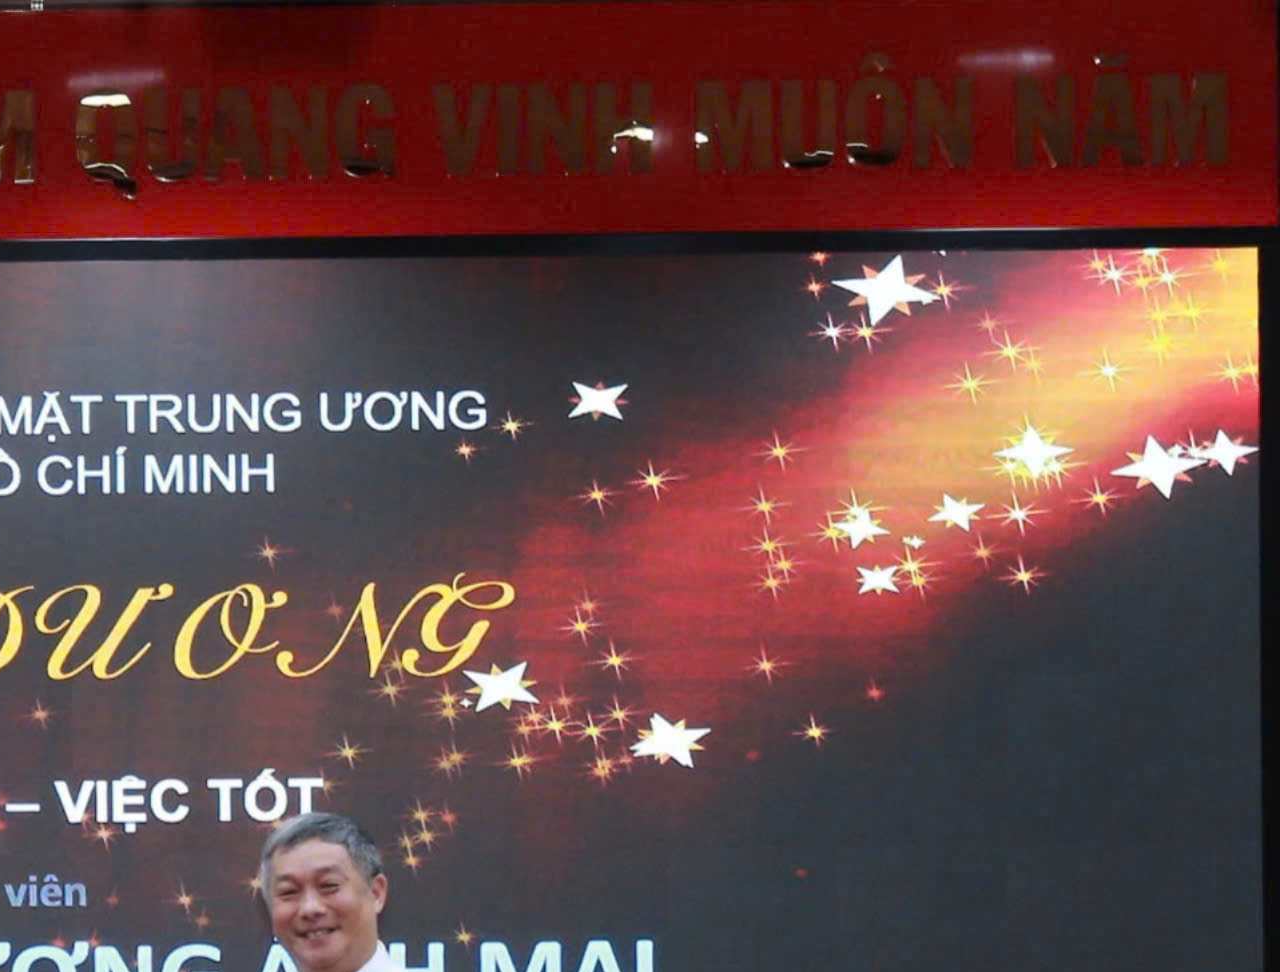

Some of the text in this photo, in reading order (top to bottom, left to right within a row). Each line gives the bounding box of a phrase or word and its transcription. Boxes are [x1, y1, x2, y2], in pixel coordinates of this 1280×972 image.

[75, 84, 396, 199] QUANG
[432, 80, 655, 176] VINH
[695, 52, 975, 174] MUÔN
[1015, 54, 1230, 170] NĂM
[115, 393, 301, 434] TRUNG
[320, 390, 488, 431] ƯƠNG
[37, 447, 127, 495] CHÍ
[145, 453, 275, 494] MINH
[54, 775, 190, 833] VIỆC
[207, 768, 324, 822] TỐT
[4, 874, 87, 908] viên
